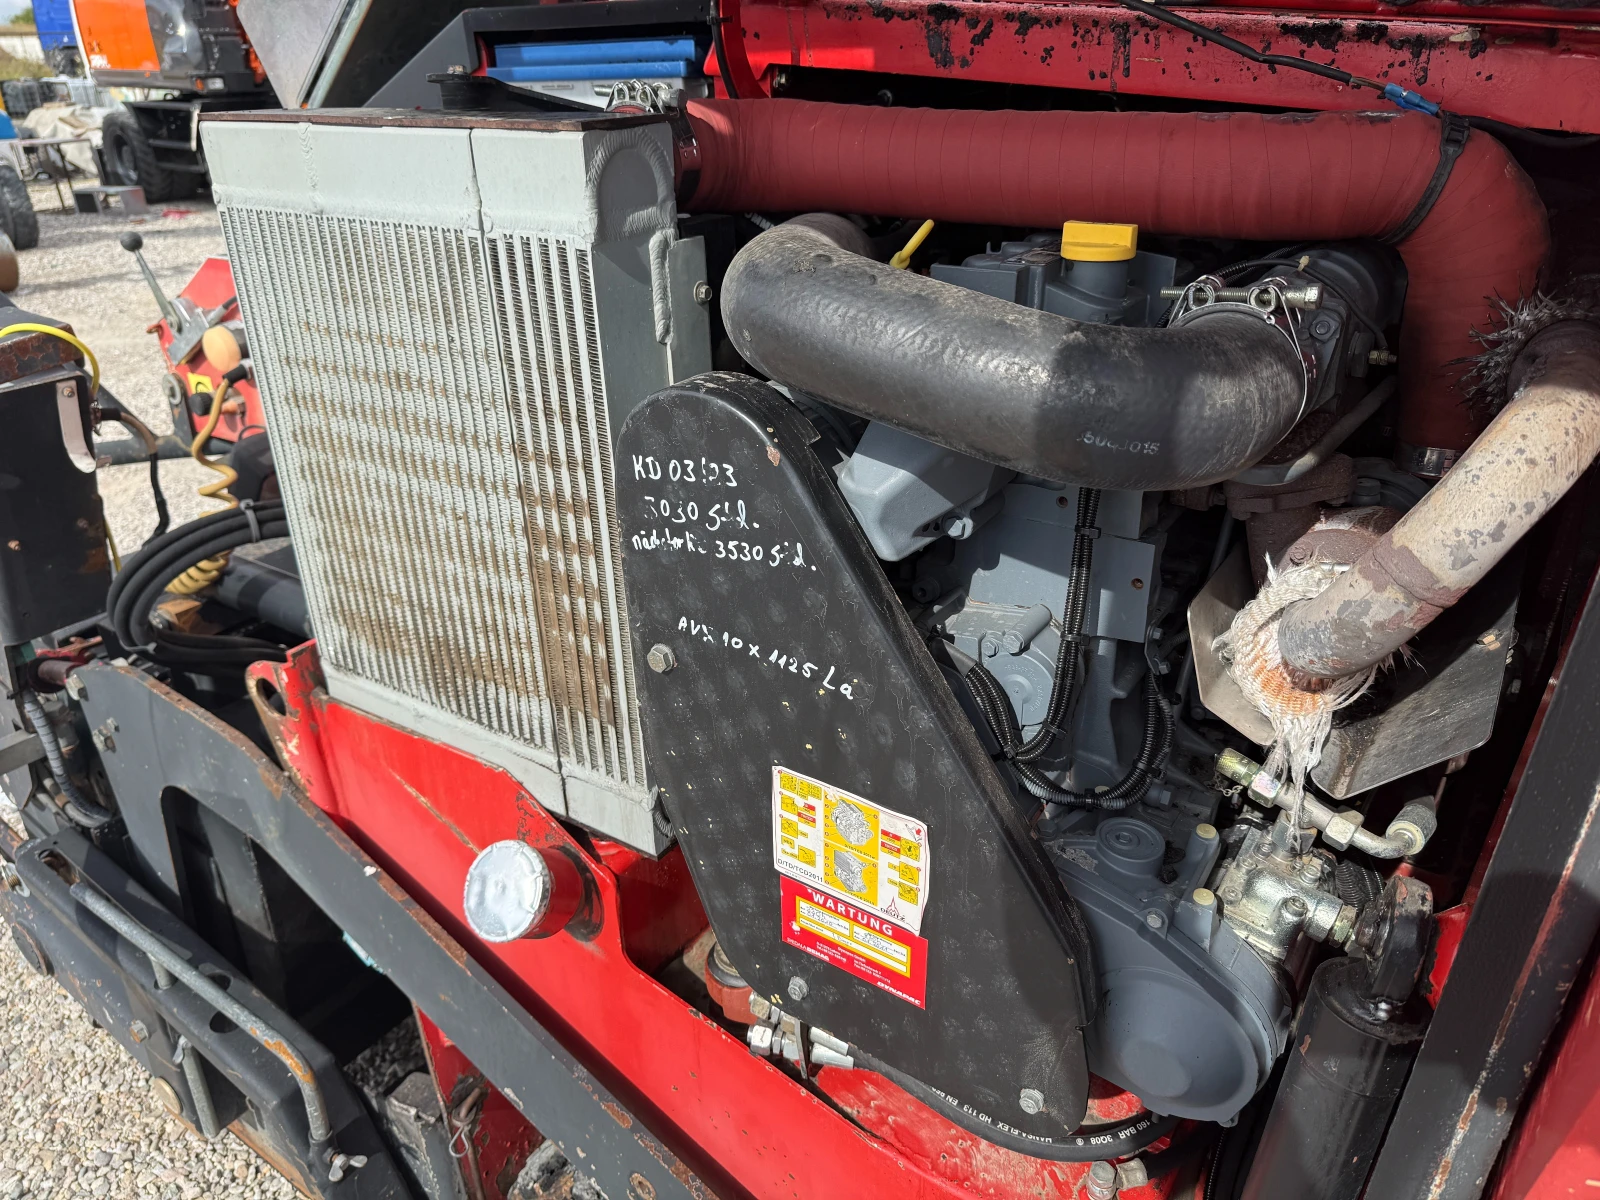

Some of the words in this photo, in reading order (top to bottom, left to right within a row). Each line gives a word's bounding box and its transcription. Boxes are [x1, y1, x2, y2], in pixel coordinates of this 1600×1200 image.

[632, 454, 661, 480] KD
[715, 540, 763, 561] 3530
[723, 632, 743, 649] 10
[769, 649, 818, 678] 1125
[812, 891, 892, 936] WARTUNG
[876, 981, 920, 1005] DYNAPAC
[945, 1094, 959, 1106] EN
[963, 1104, 978, 1117] 113
[979, 1112, 992, 1124] HD
[1136, 1120, 1151, 1131] 160
[1090, 1134, 1113, 1145] 3Q08
[1118, 1126, 1137, 1141] BAR
